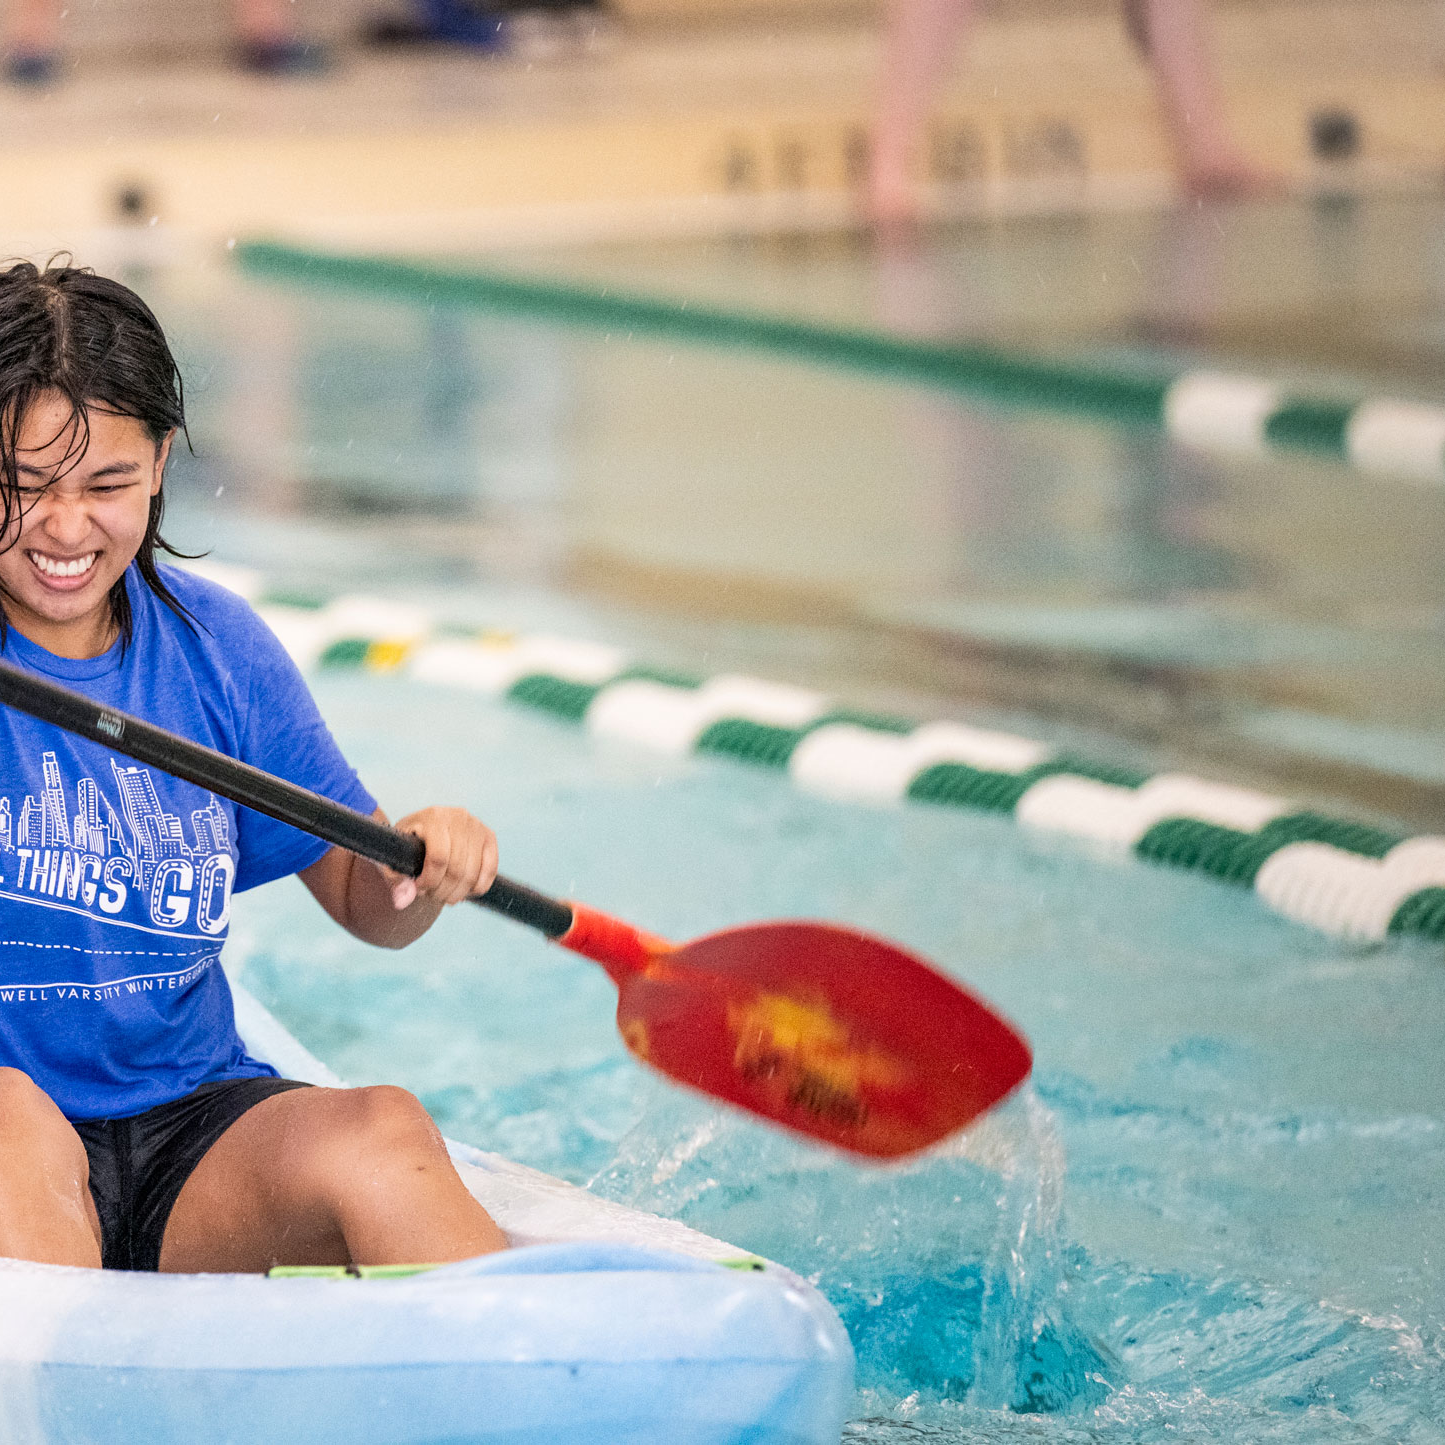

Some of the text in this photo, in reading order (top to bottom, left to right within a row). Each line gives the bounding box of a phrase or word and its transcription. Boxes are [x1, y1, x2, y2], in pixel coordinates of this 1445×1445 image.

[16, 848, 134, 914] THINGS
[149, 853, 235, 935] GO
[57, 986, 121, 1001] VARSITY
